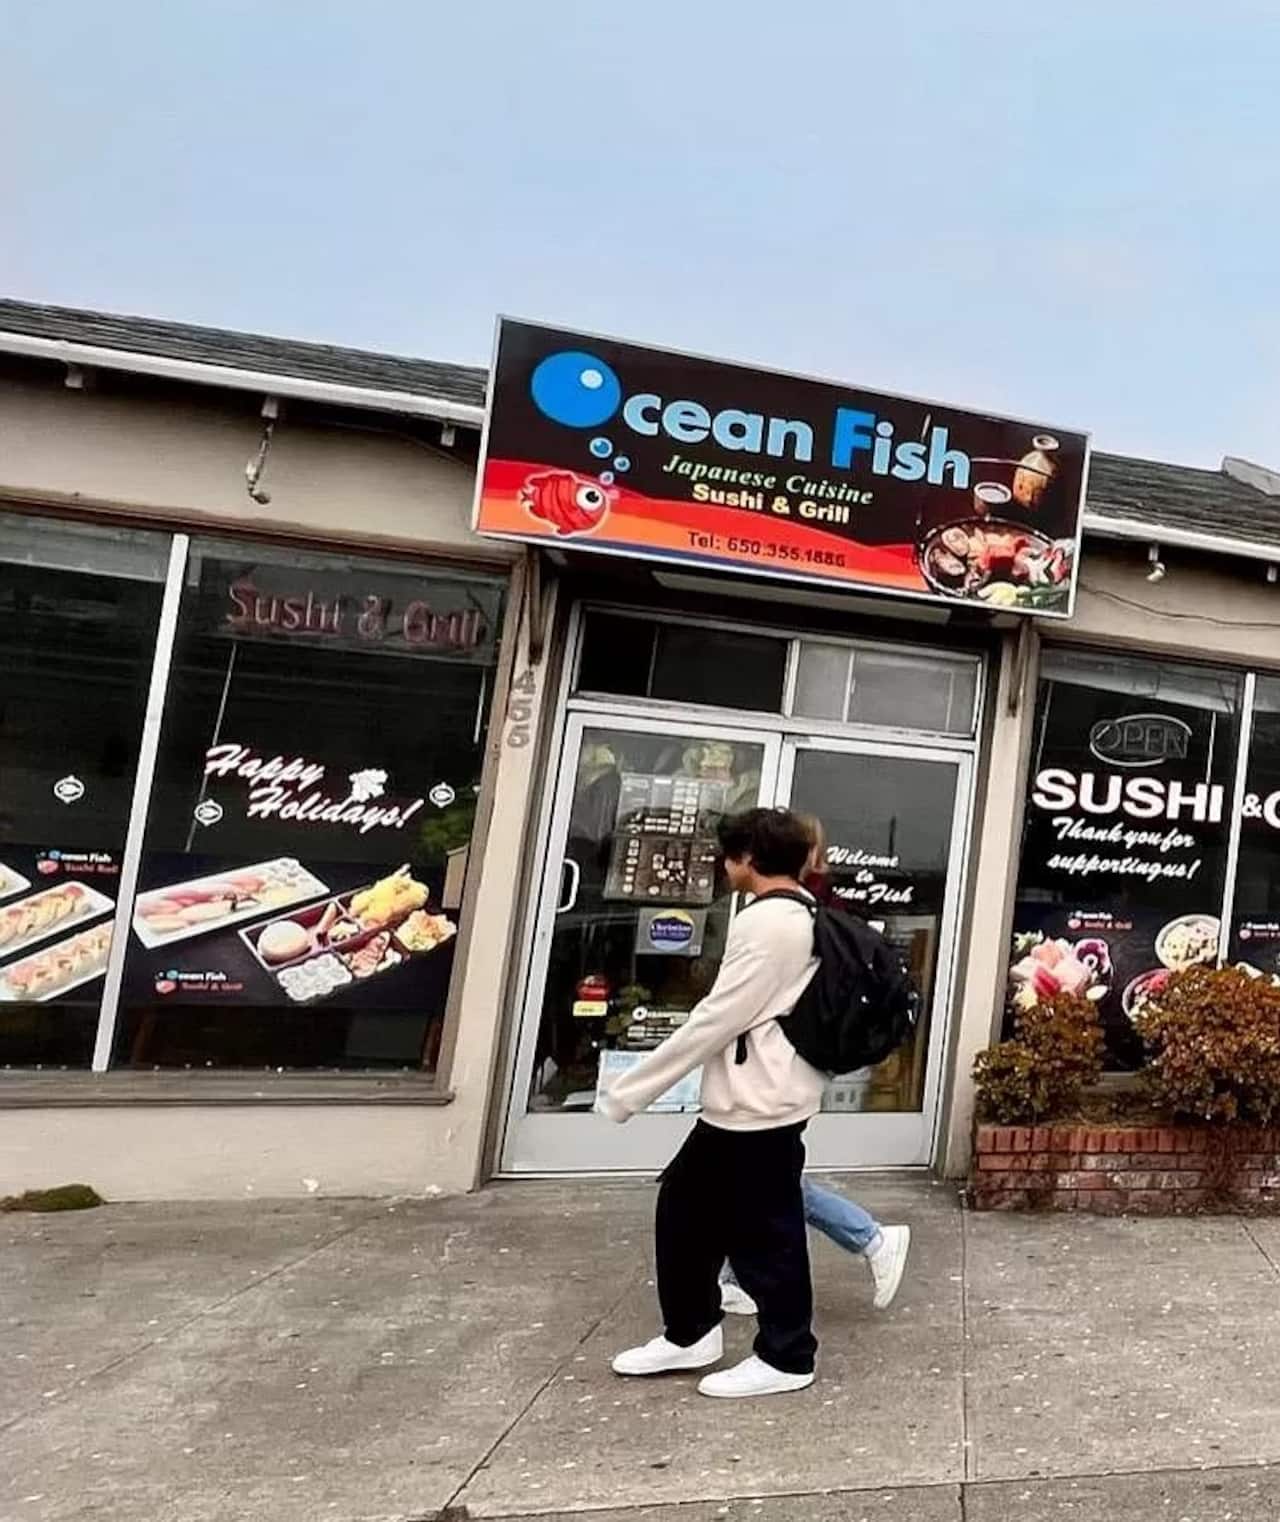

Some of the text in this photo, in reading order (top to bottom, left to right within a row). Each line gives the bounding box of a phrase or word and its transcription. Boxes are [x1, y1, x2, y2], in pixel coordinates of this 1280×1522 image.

[832, 406, 971, 489] Fish
[662, 454, 874, 504] Japanese Cuisine
[692, 483, 850, 524] Sushi & Grill
[688, 531, 721, 550] Tel:
[226, 580, 485, 647] Sushi & Grill
[1090, 720, 1189, 759] OPEN
[204, 744, 325, 789] Happy
[247, 786, 425, 834] Holidays!
[1032, 768, 1224, 823] SUSHI
[1241, 793, 1263, 819] &
[1052, 816, 1124, 843] Thank
[827, 846, 899, 868] Welcome
[856, 869, 874, 884] to
[868, 883, 914, 904] Fish
